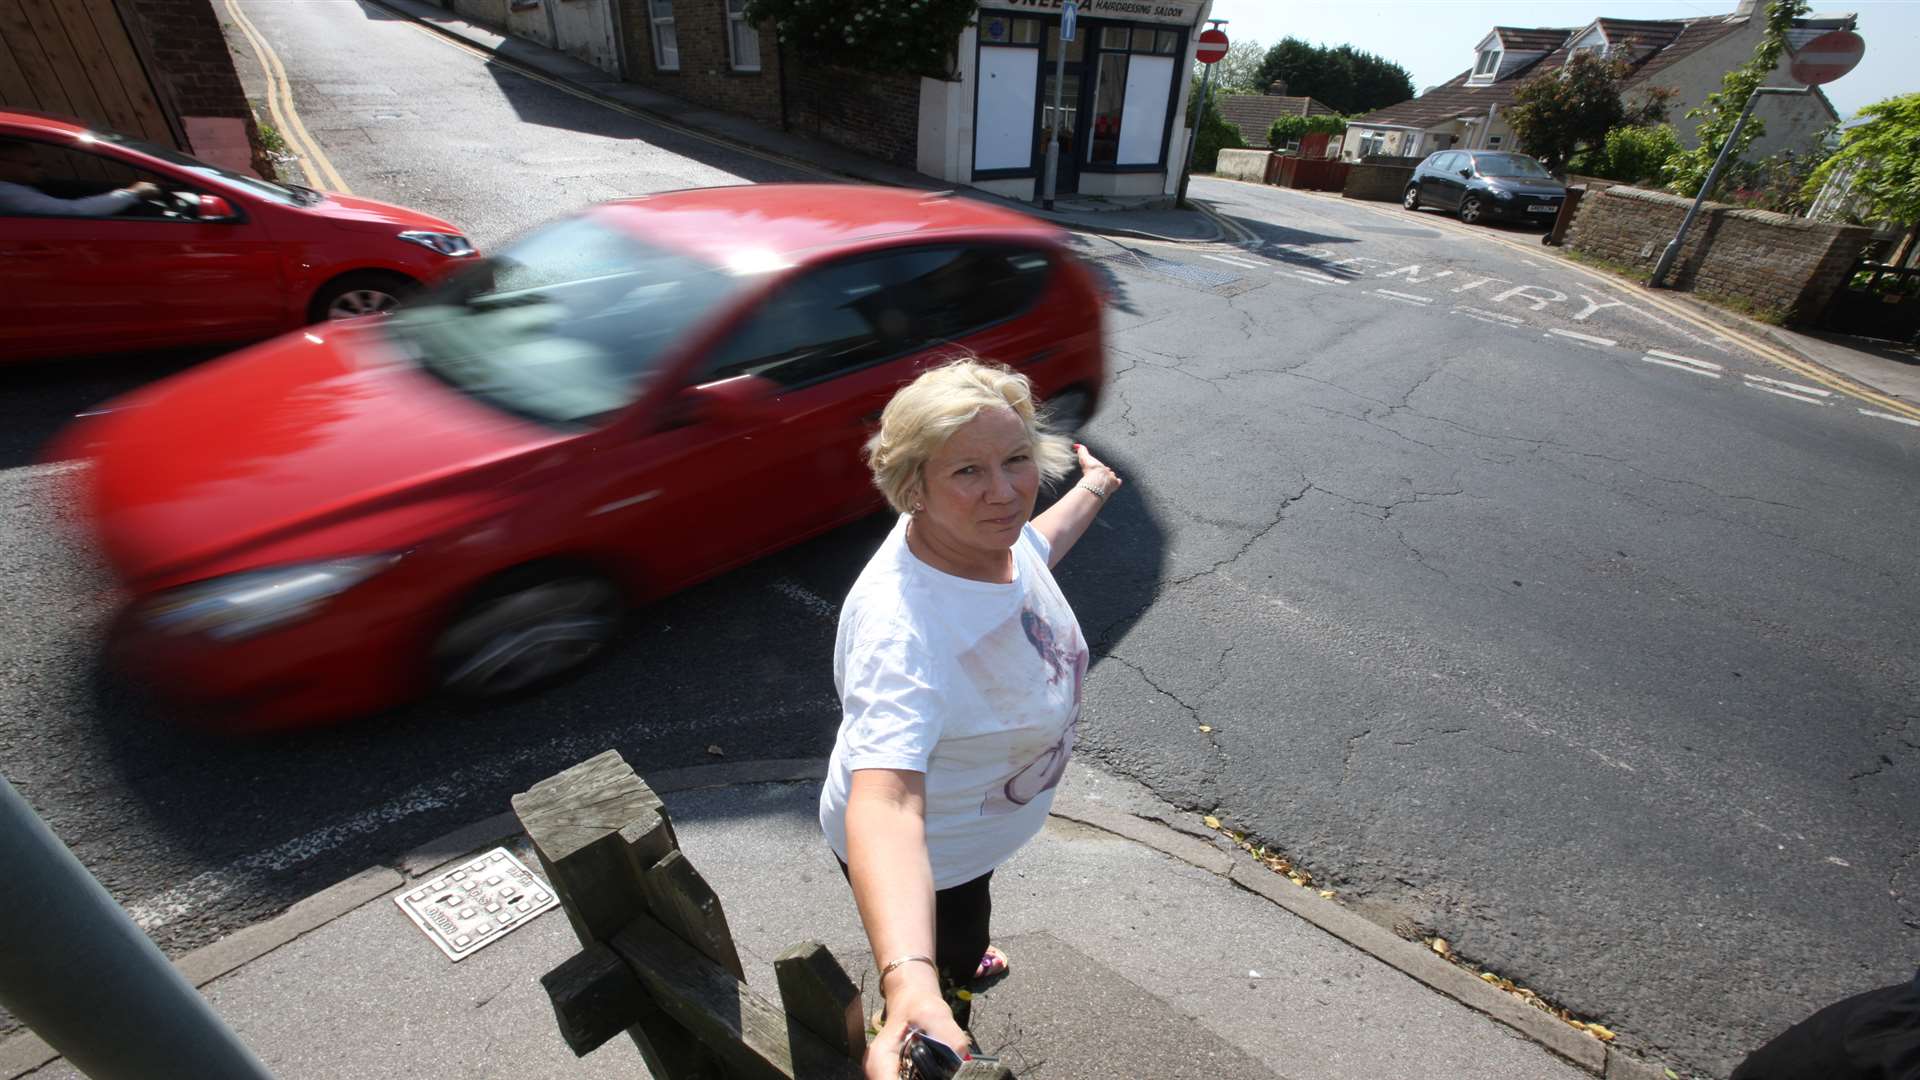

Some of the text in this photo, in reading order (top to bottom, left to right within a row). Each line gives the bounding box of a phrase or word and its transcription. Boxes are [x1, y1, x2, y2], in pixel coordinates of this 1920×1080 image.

[1096, 0, 1152, 14] HAIRDRESSING
[1154, 6, 1184, 17] SALOON
[1329, 256, 1620, 320] ENTRY
[423, 904, 458, 935] LONDON
